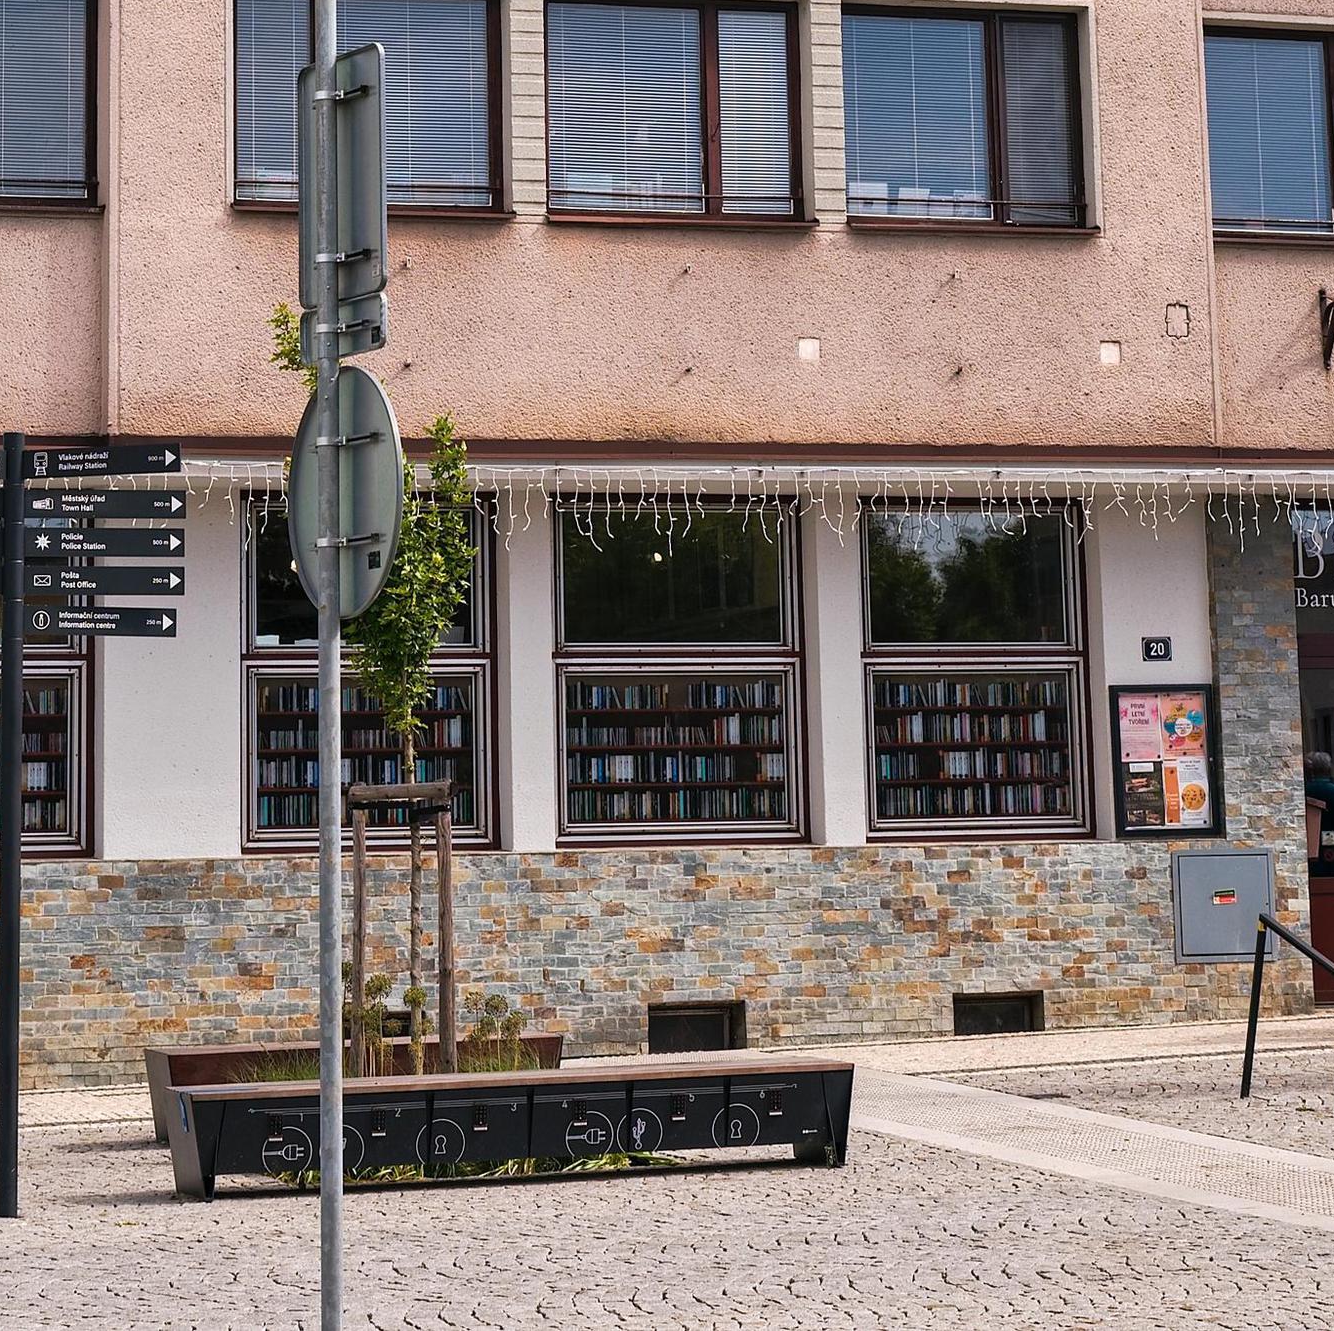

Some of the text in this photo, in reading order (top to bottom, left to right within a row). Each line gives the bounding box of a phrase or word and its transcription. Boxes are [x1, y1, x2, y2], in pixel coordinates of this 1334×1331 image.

[58, 453, 83, 461] Vlakové
[59, 462, 83, 471] Railway
[62, 495, 89, 503] Městský
[61, 571, 79, 579] Pošta
[59, 611, 92, 619] Informační
[59, 621, 95, 629] Information
[1150, 642, 1165, 656] 20
[689, 1094, 695, 1102] 5
[511, 1103, 517, 1111] 3
[395, 1108, 401, 1117] 2
